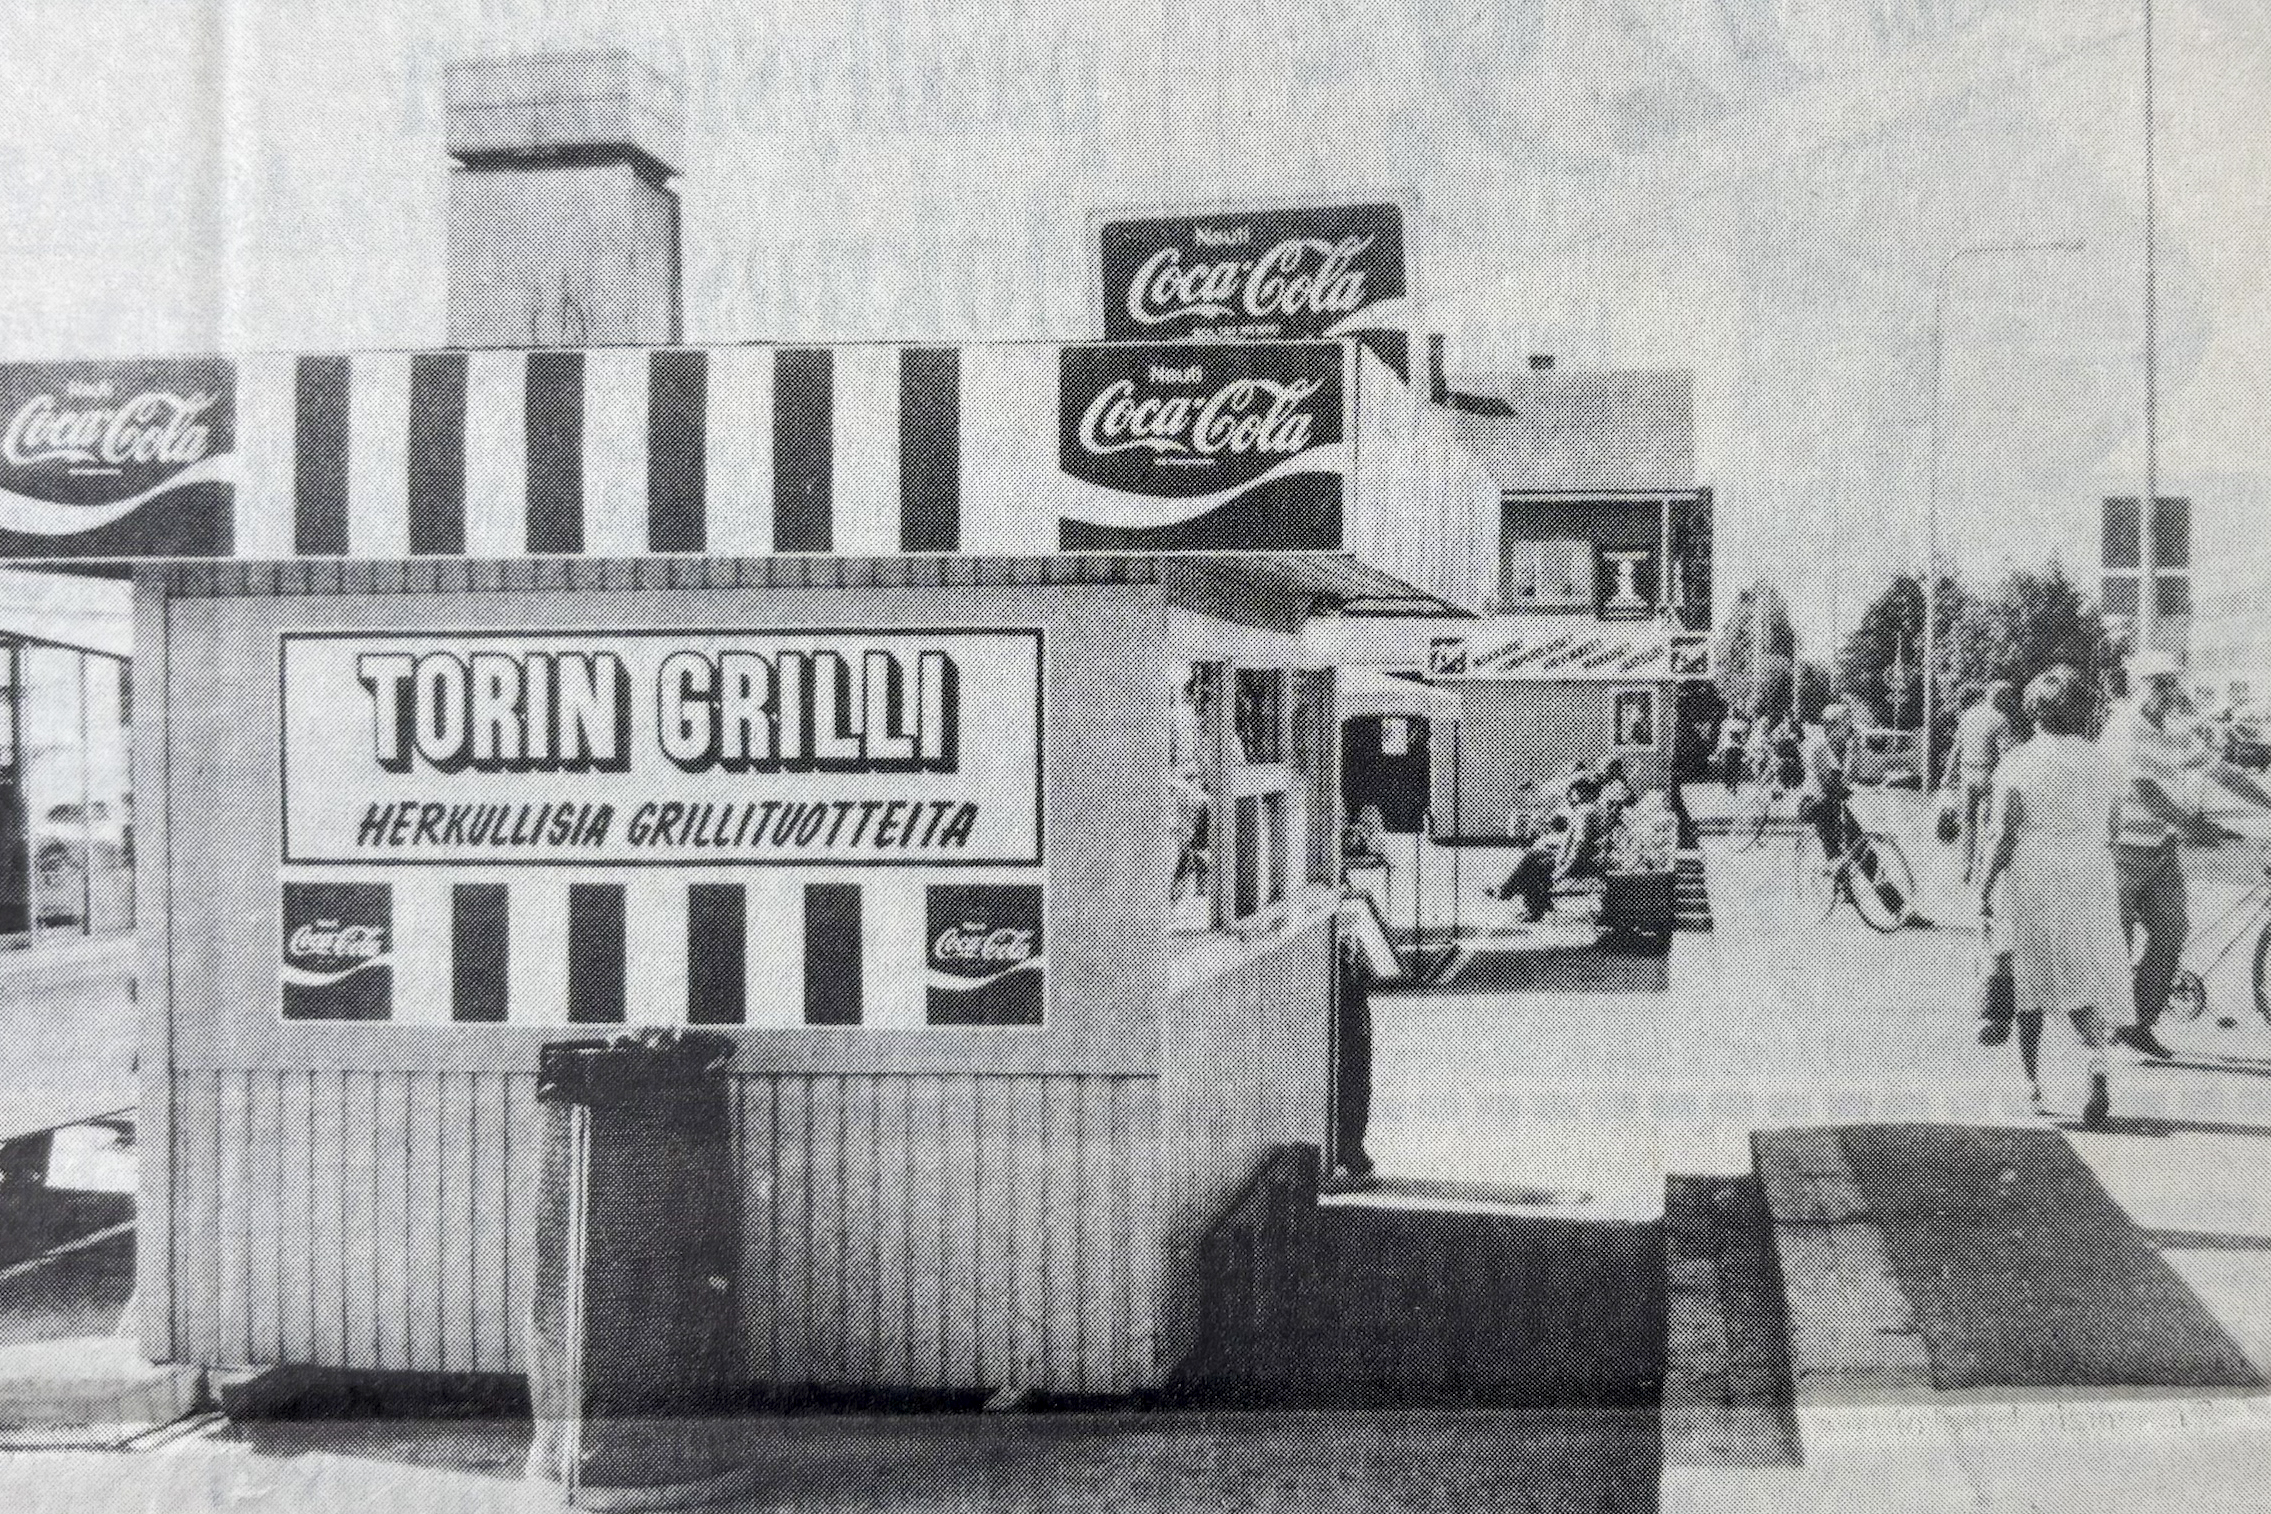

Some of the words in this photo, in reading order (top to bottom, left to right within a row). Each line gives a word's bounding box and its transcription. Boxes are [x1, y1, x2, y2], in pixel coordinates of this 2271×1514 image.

[1194, 226, 1250, 247] Nauti
[1127, 233, 1375, 324] Coca-Cola
[1149, 365, 1203, 383] Nauti
[3, 390, 220, 466] Coca-Cola
[1079, 376, 1324, 455] Coca-Cola
[356, 650, 633, 775] TORIN
[656, 649, 961, 774] GRILLI
[356, 801, 616, 847] HERKULLISIA
[627, 800, 980, 848] GRILLITUOTTEITA
